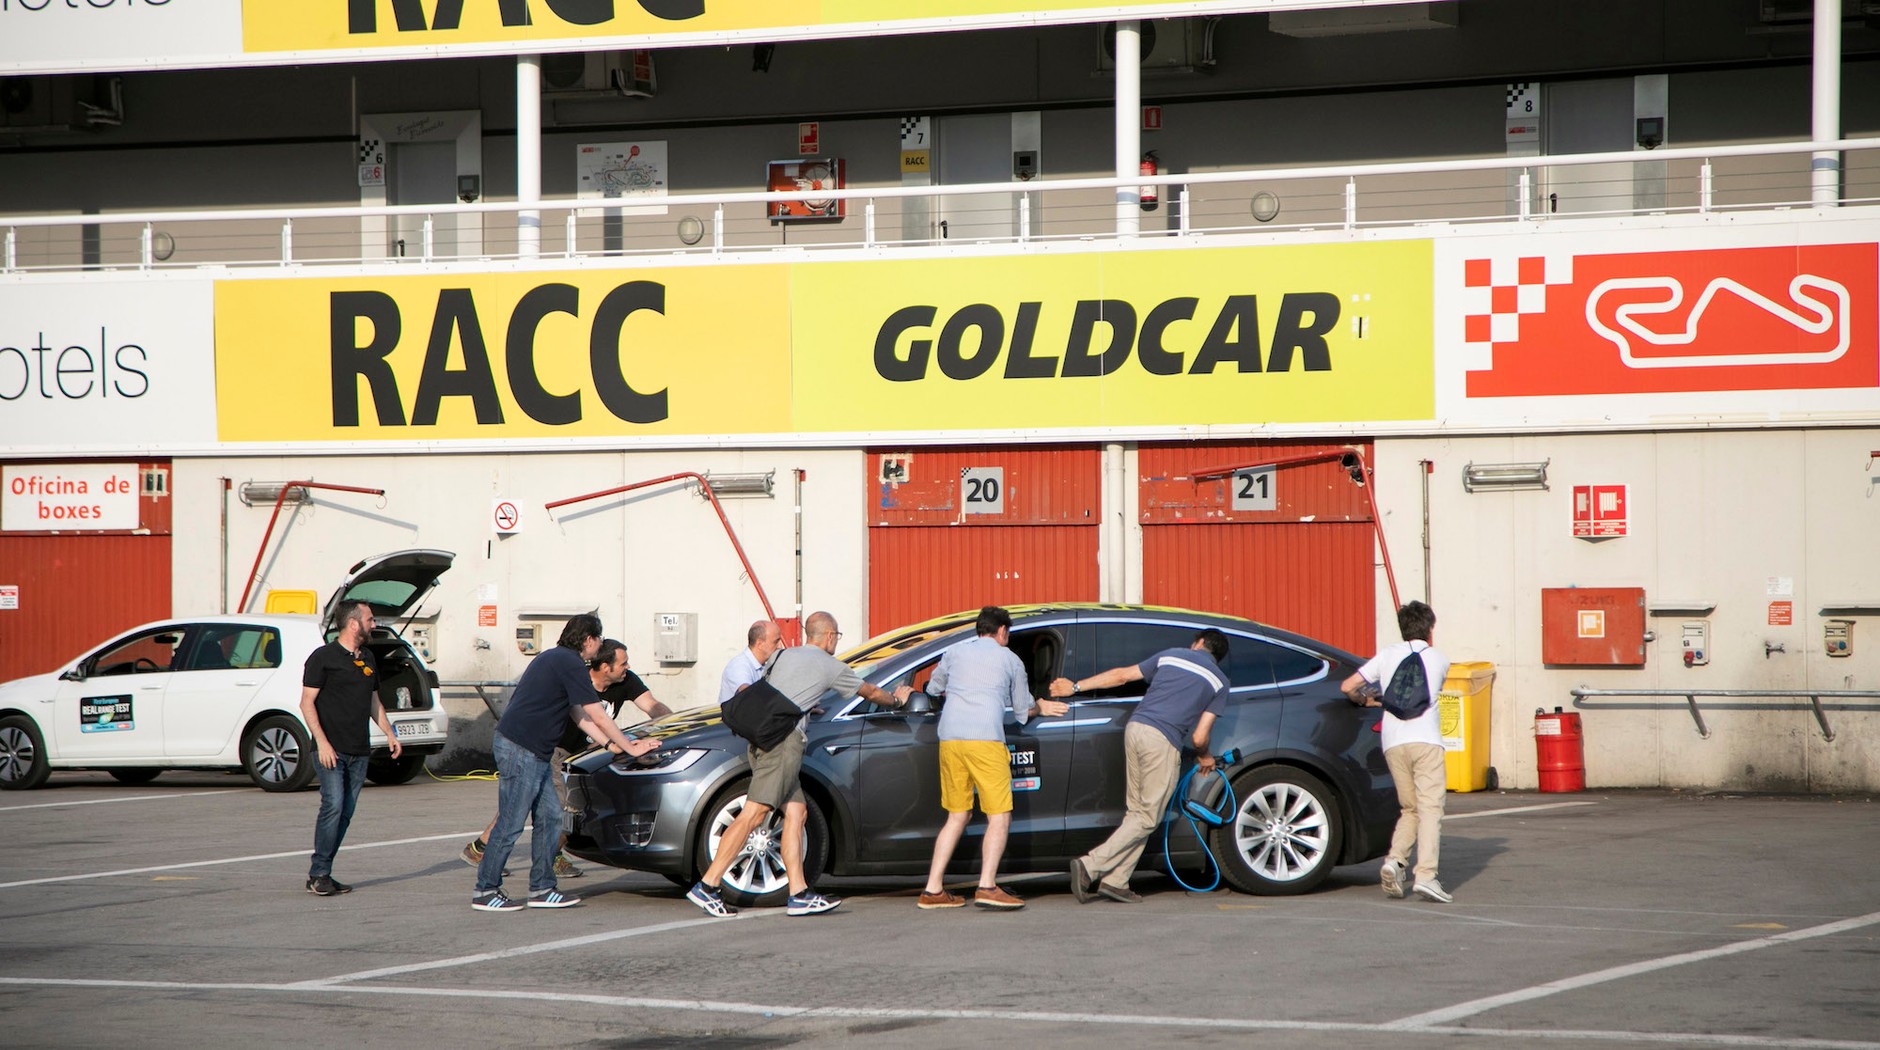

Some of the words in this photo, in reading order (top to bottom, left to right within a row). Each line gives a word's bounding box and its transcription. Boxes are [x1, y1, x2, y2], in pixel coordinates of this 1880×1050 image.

[1525, 100, 1533, 112] 8
[917, 133, 924, 144] 7
[376, 153, 383, 164] 6
[905, 157, 925, 165] RACC
[373, 166, 380, 178] 6
[874, 292, 1341, 382] GOLDCAR
[330, 280, 669, 427] RACC
[11, 476, 88, 495] Oficina
[104, 475, 131, 494] de
[966, 478, 999, 502] 20
[1238, 473, 1269, 499] 21
[38, 501, 102, 519] boxes
[663, 616, 678, 625] Tel.
[82, 705, 98, 715] REAL
[115, 703, 130, 713] TEST
[398, 724, 416, 735] 9923
[1011, 751, 1035, 765] TEST
